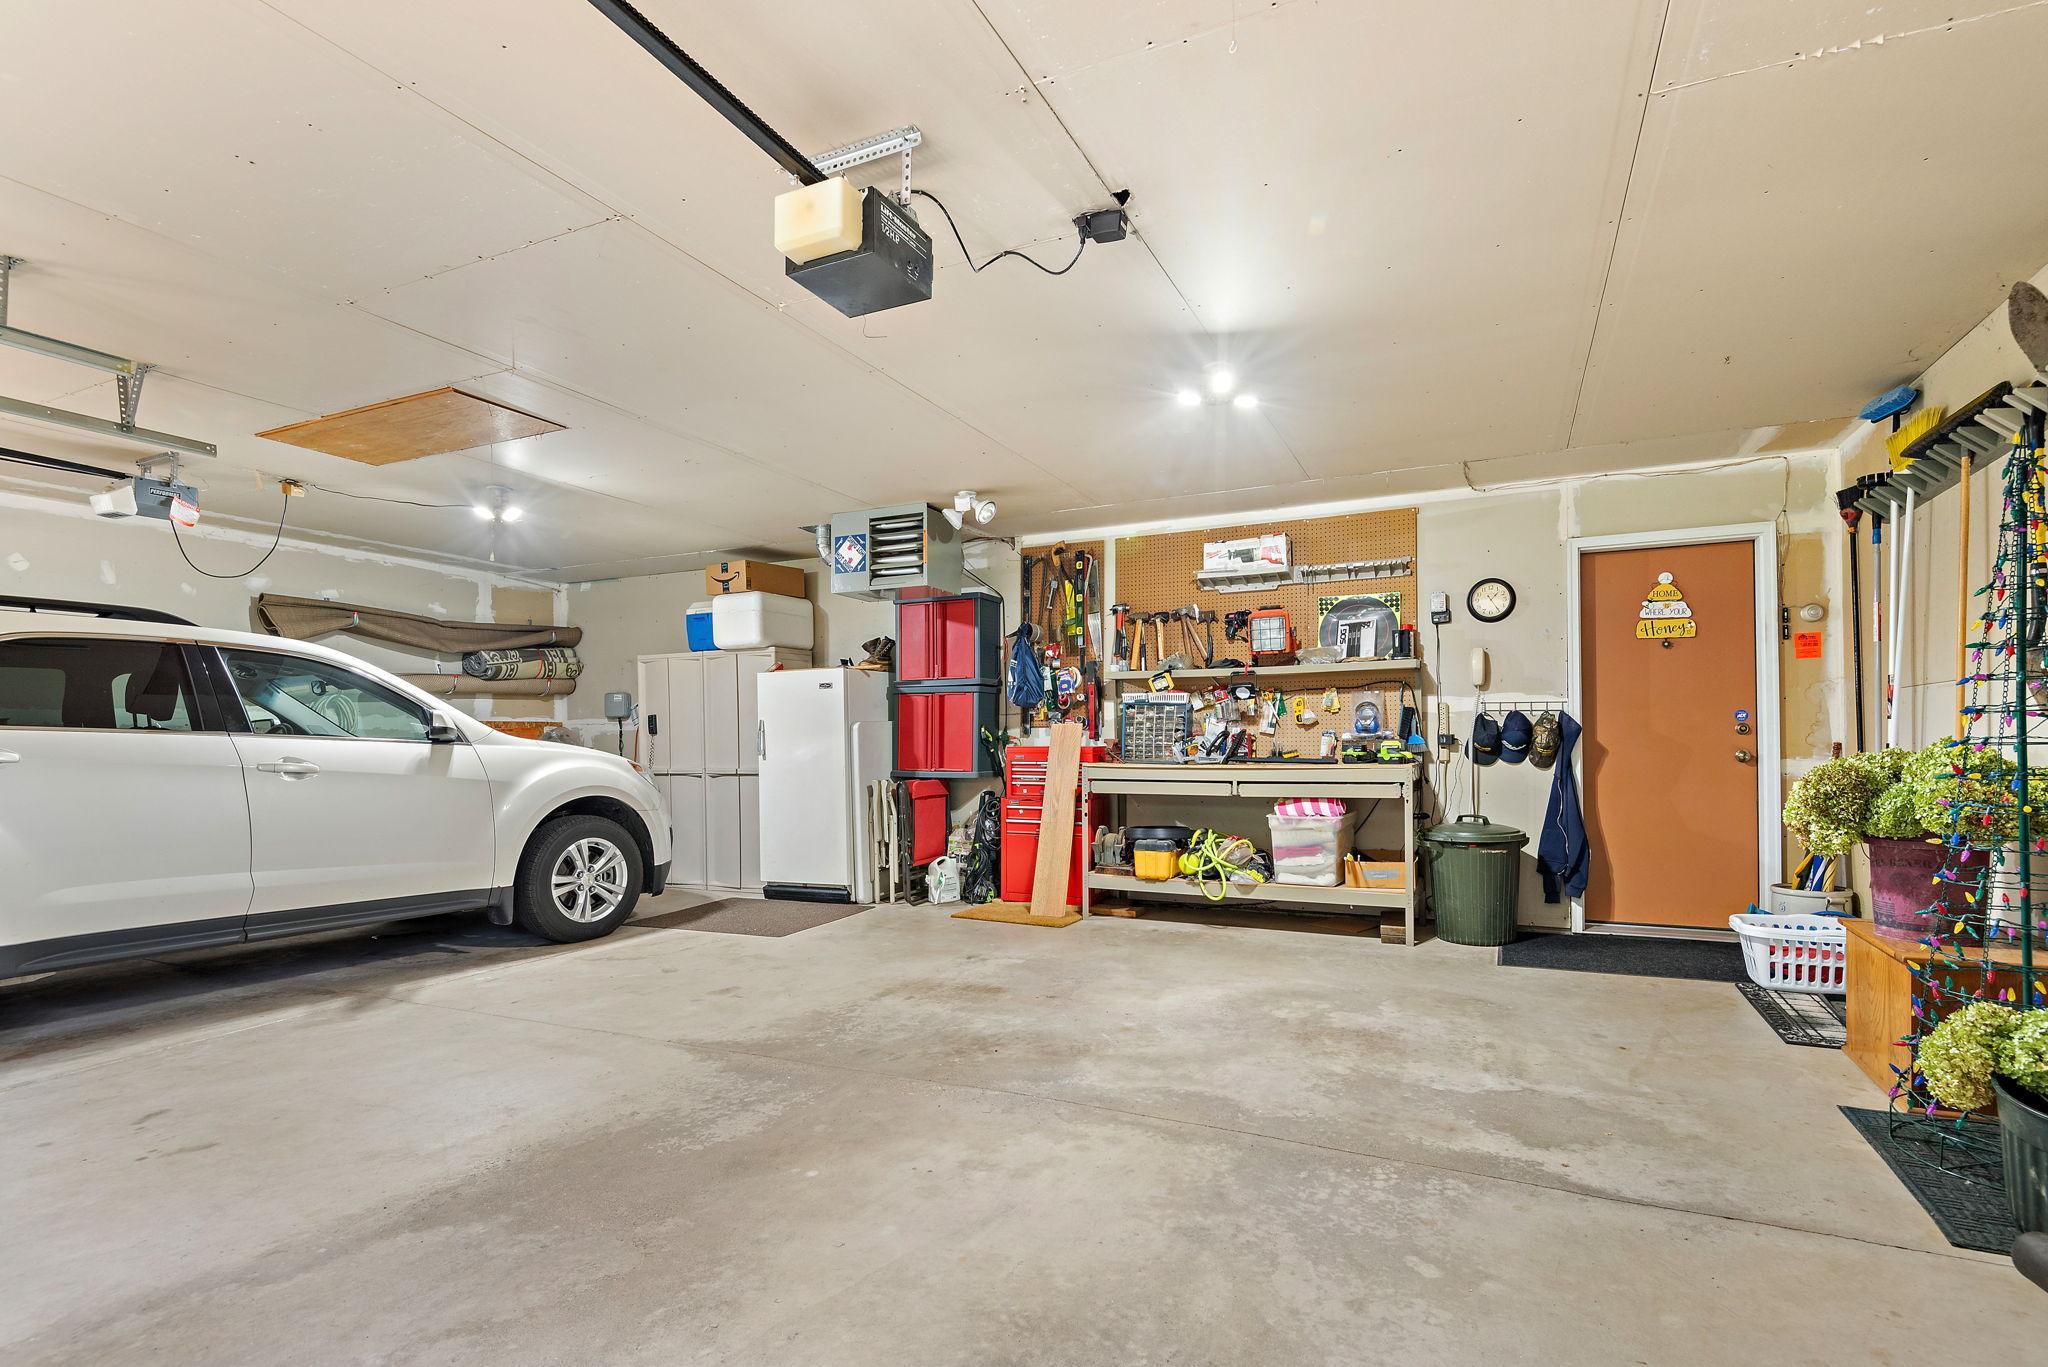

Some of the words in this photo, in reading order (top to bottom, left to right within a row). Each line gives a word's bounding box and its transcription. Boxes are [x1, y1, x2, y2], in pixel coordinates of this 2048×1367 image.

[1652, 590, 1679, 598] HOME
[1644, 608, 1665, 616] WHERE
[1669, 608, 1687, 616] YOUR
[1640, 620, 1686, 637] Honey
